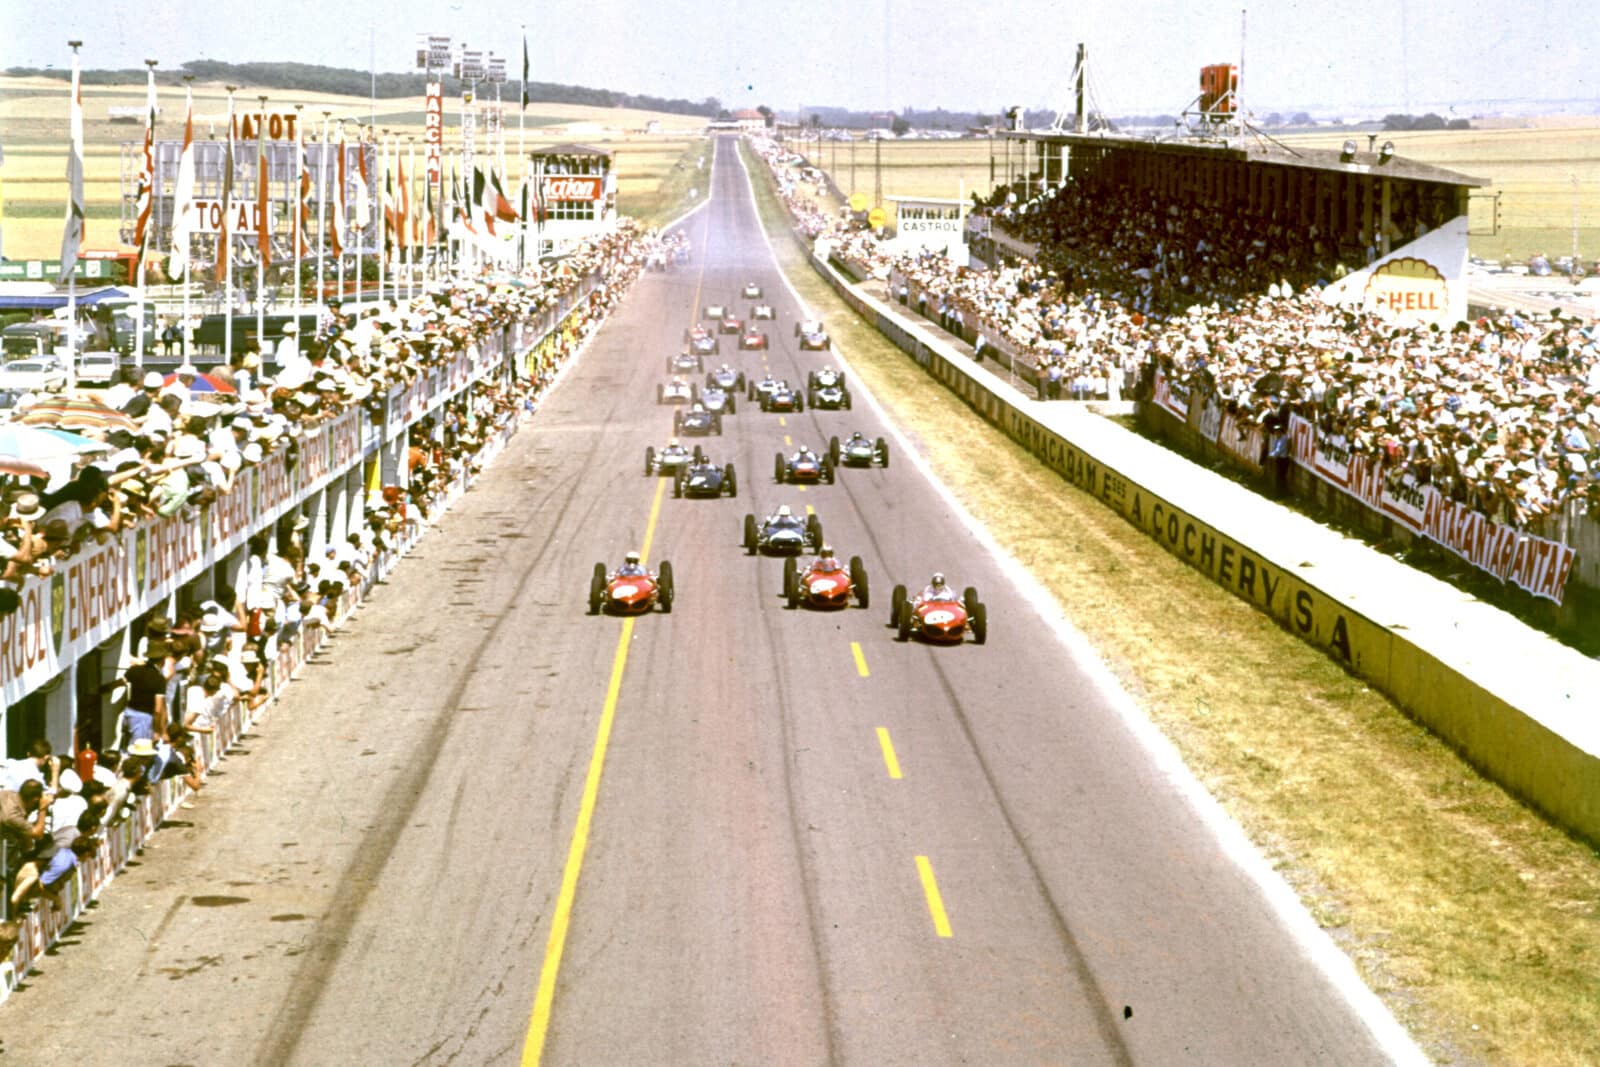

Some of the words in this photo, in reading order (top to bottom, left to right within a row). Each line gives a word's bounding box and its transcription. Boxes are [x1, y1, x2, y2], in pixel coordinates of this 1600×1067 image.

[903, 222, 958, 232] CASTROL
[1153, 503, 1280, 610] COCHERY
[1510, 538, 1573, 599] ANTAR
